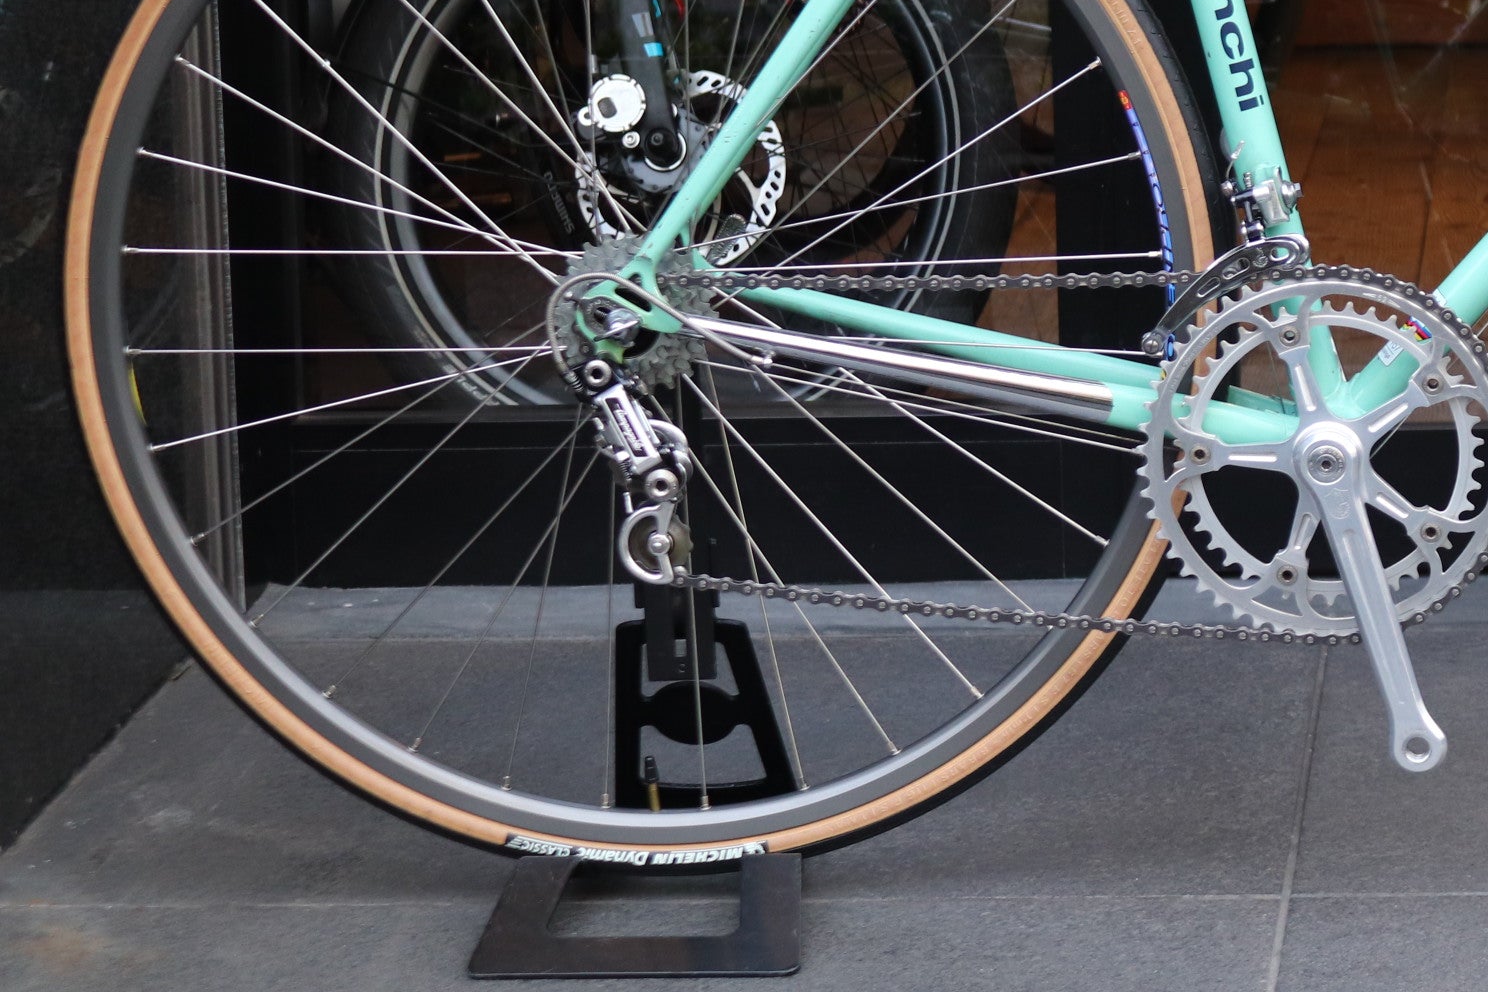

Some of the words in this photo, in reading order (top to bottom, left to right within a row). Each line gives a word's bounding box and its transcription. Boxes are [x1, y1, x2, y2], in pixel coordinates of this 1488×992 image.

[518, 837, 571, 856] CLASSIC
[577, 846, 649, 866] Dynamic
[652, 845, 743, 865] MICHELIN
